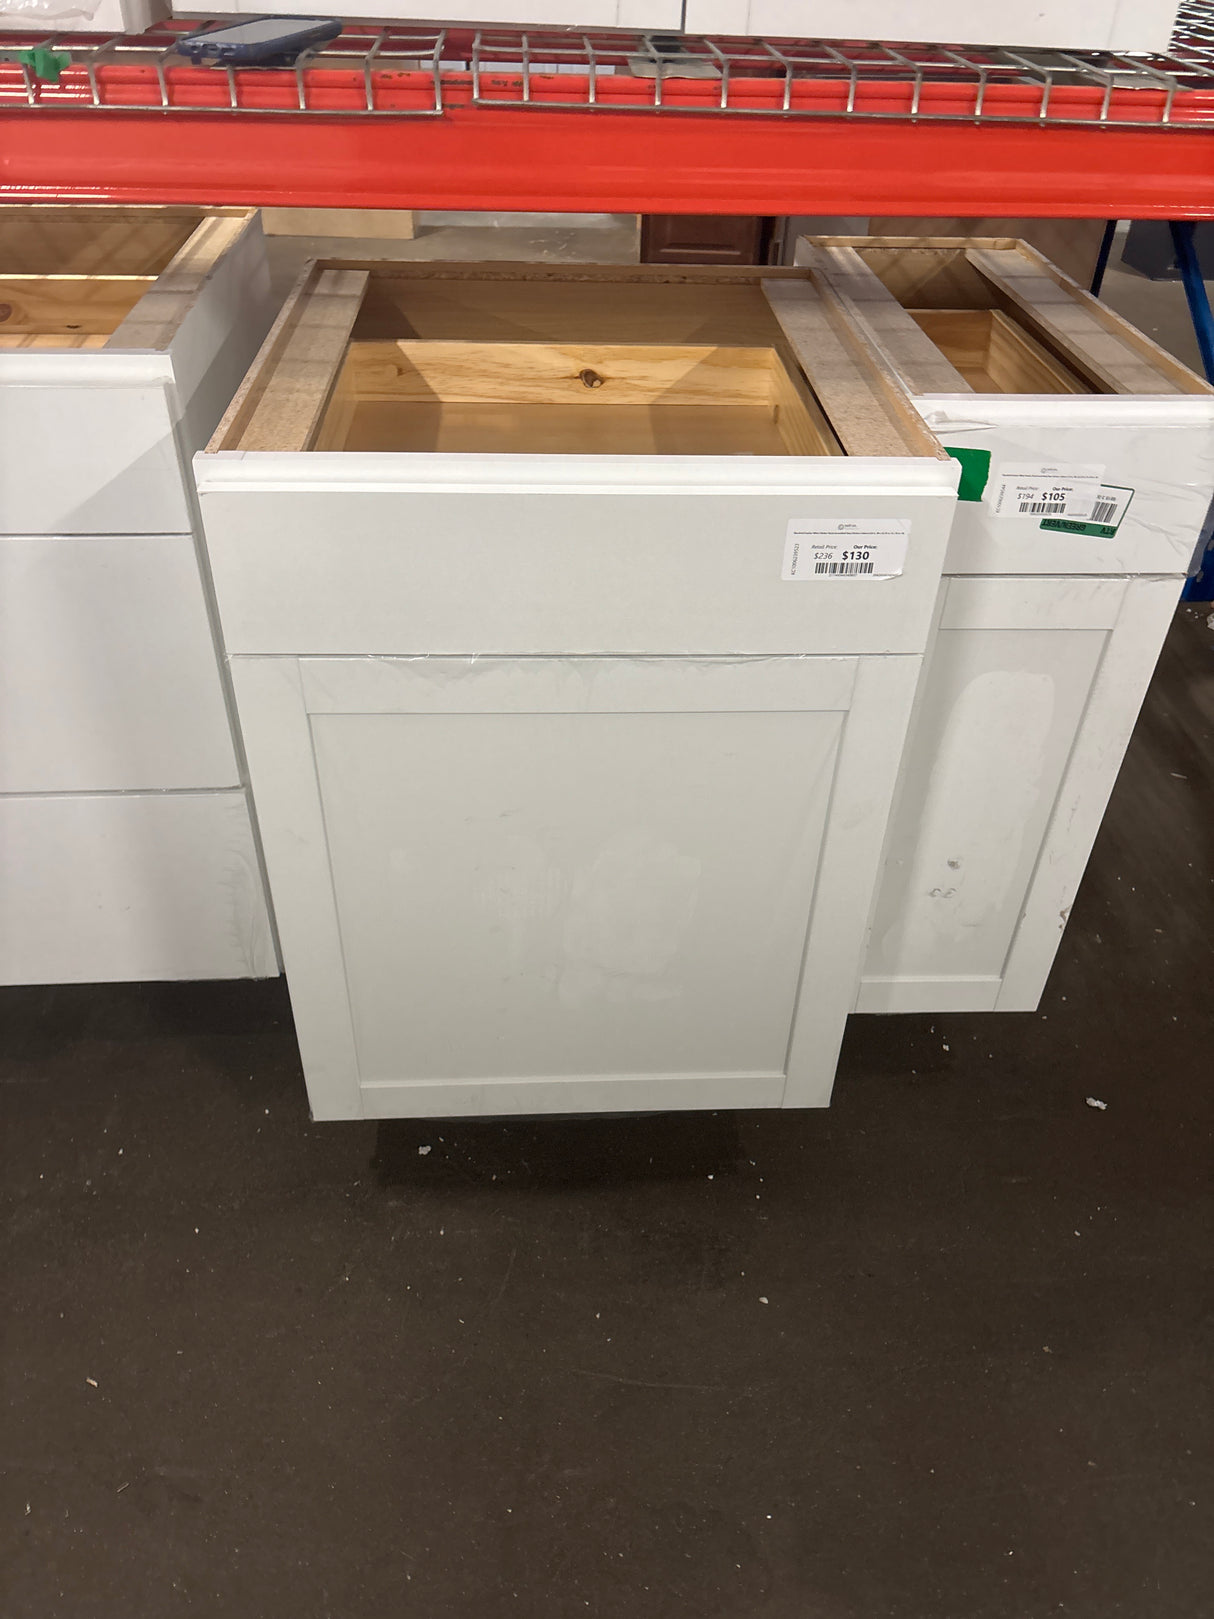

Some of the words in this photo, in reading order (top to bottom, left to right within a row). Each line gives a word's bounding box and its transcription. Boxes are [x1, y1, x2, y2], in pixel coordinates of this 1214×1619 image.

[1042, 492, 1066, 501] $105
[813, 552, 833, 560] $236
[842, 551, 870, 561] $130
